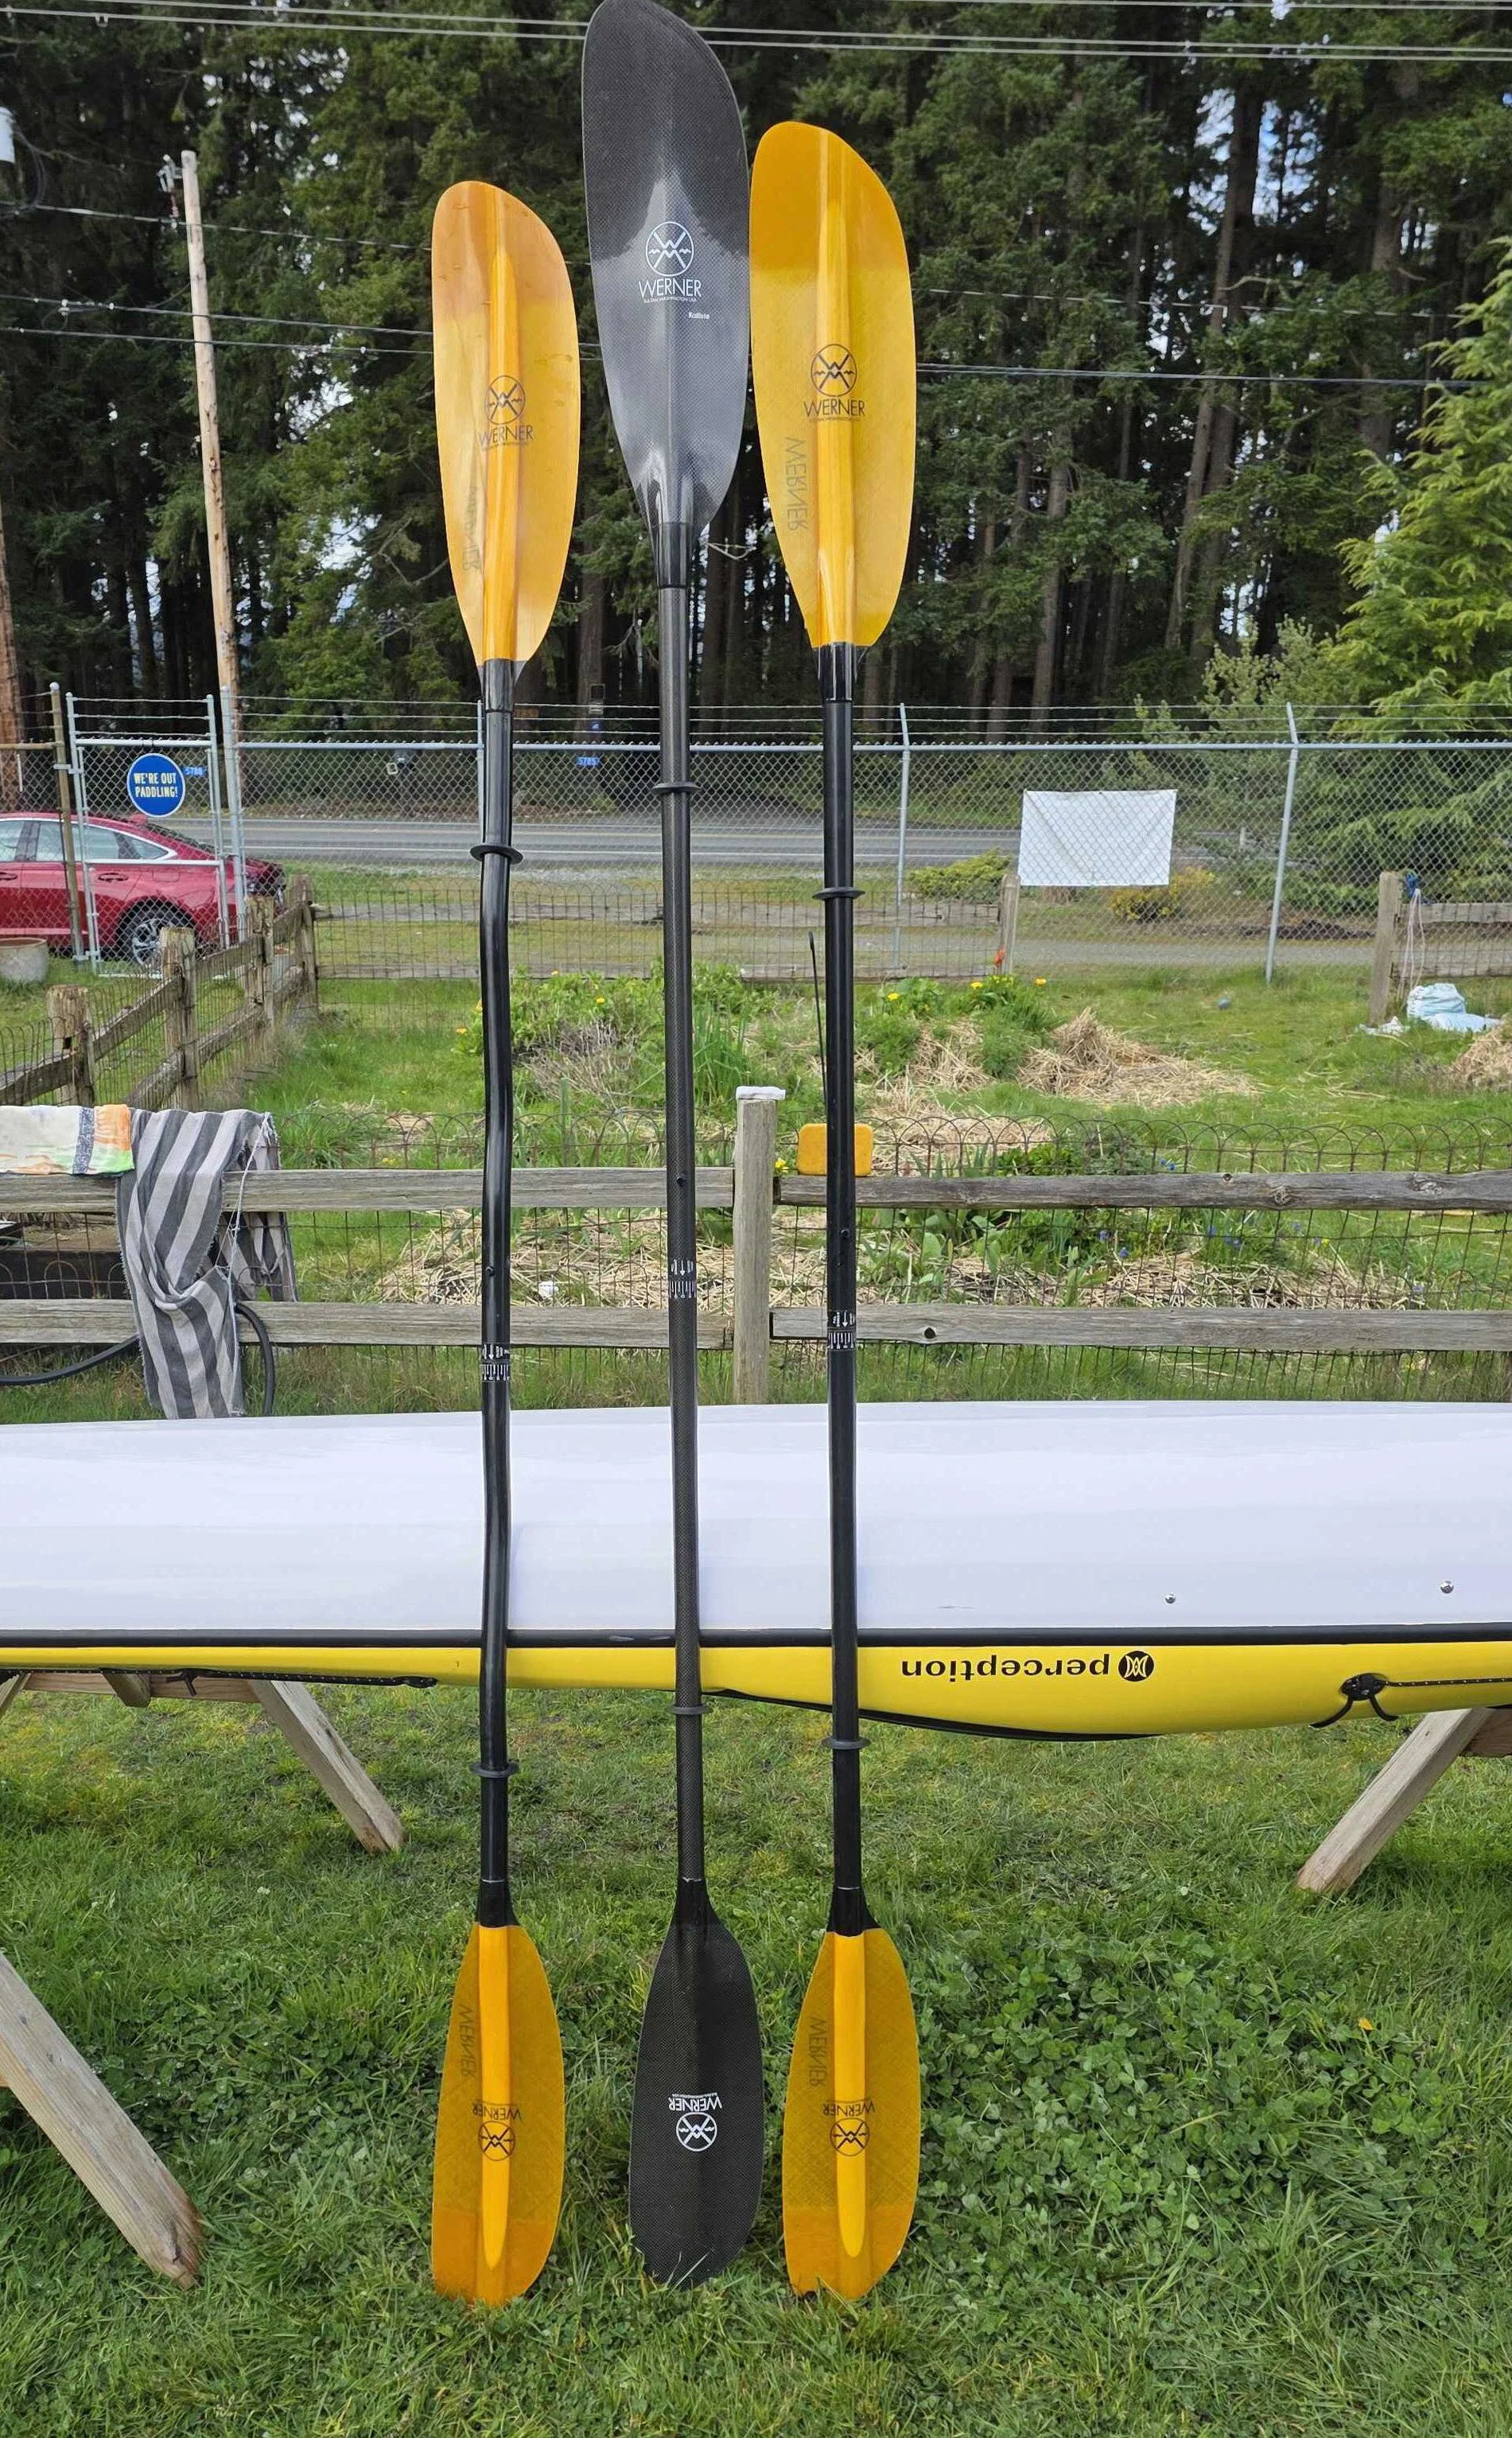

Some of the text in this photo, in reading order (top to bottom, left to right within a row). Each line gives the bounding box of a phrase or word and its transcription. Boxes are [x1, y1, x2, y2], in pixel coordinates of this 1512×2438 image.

[639, 278, 702, 299] WERNER
[803, 399, 865, 418] WERNER
[479, 425, 534, 445] WERNER
[133, 772, 177, 784] WE'RE OUT
[134, 786, 178, 798] PADDLING!
[901, 1653, 1110, 1682] perception
[472, 2102, 523, 2121] WERNER
[668, 2095, 723, 2112] WERNER
[822, 2100, 876, 2117] WERNER
